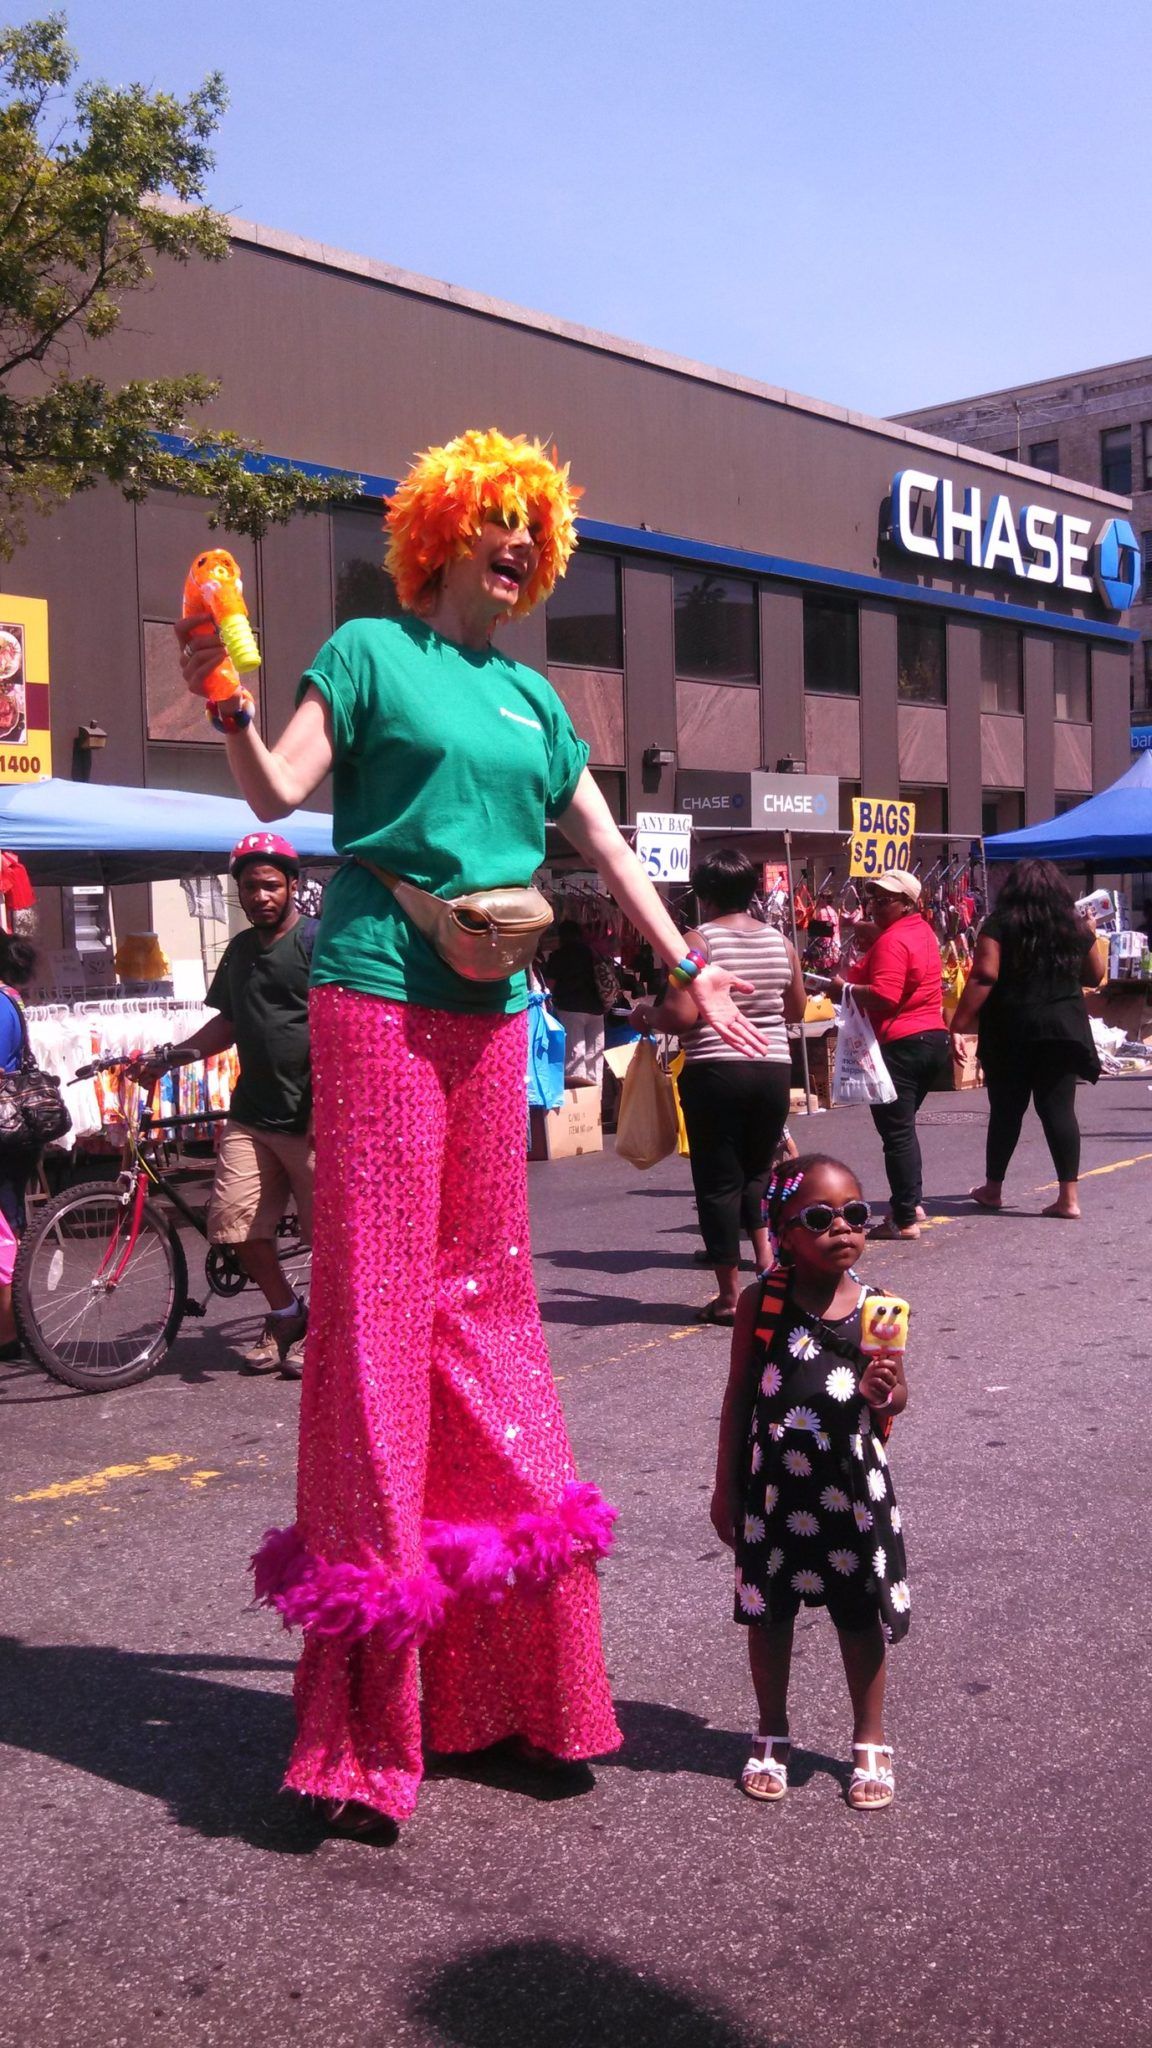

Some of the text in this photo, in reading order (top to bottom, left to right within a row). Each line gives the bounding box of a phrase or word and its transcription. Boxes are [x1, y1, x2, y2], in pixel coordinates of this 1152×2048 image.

[895, 468, 1093, 594] CHASE
[682, 795, 730, 810] CHASE
[763, 794, 813, 813] CHASE
[640, 816, 690, 832] ANY BAG
[859, 802, 911, 836] BAGS
[639, 846, 689, 877] $5.00
[854, 839, 909, 874] $5.00
